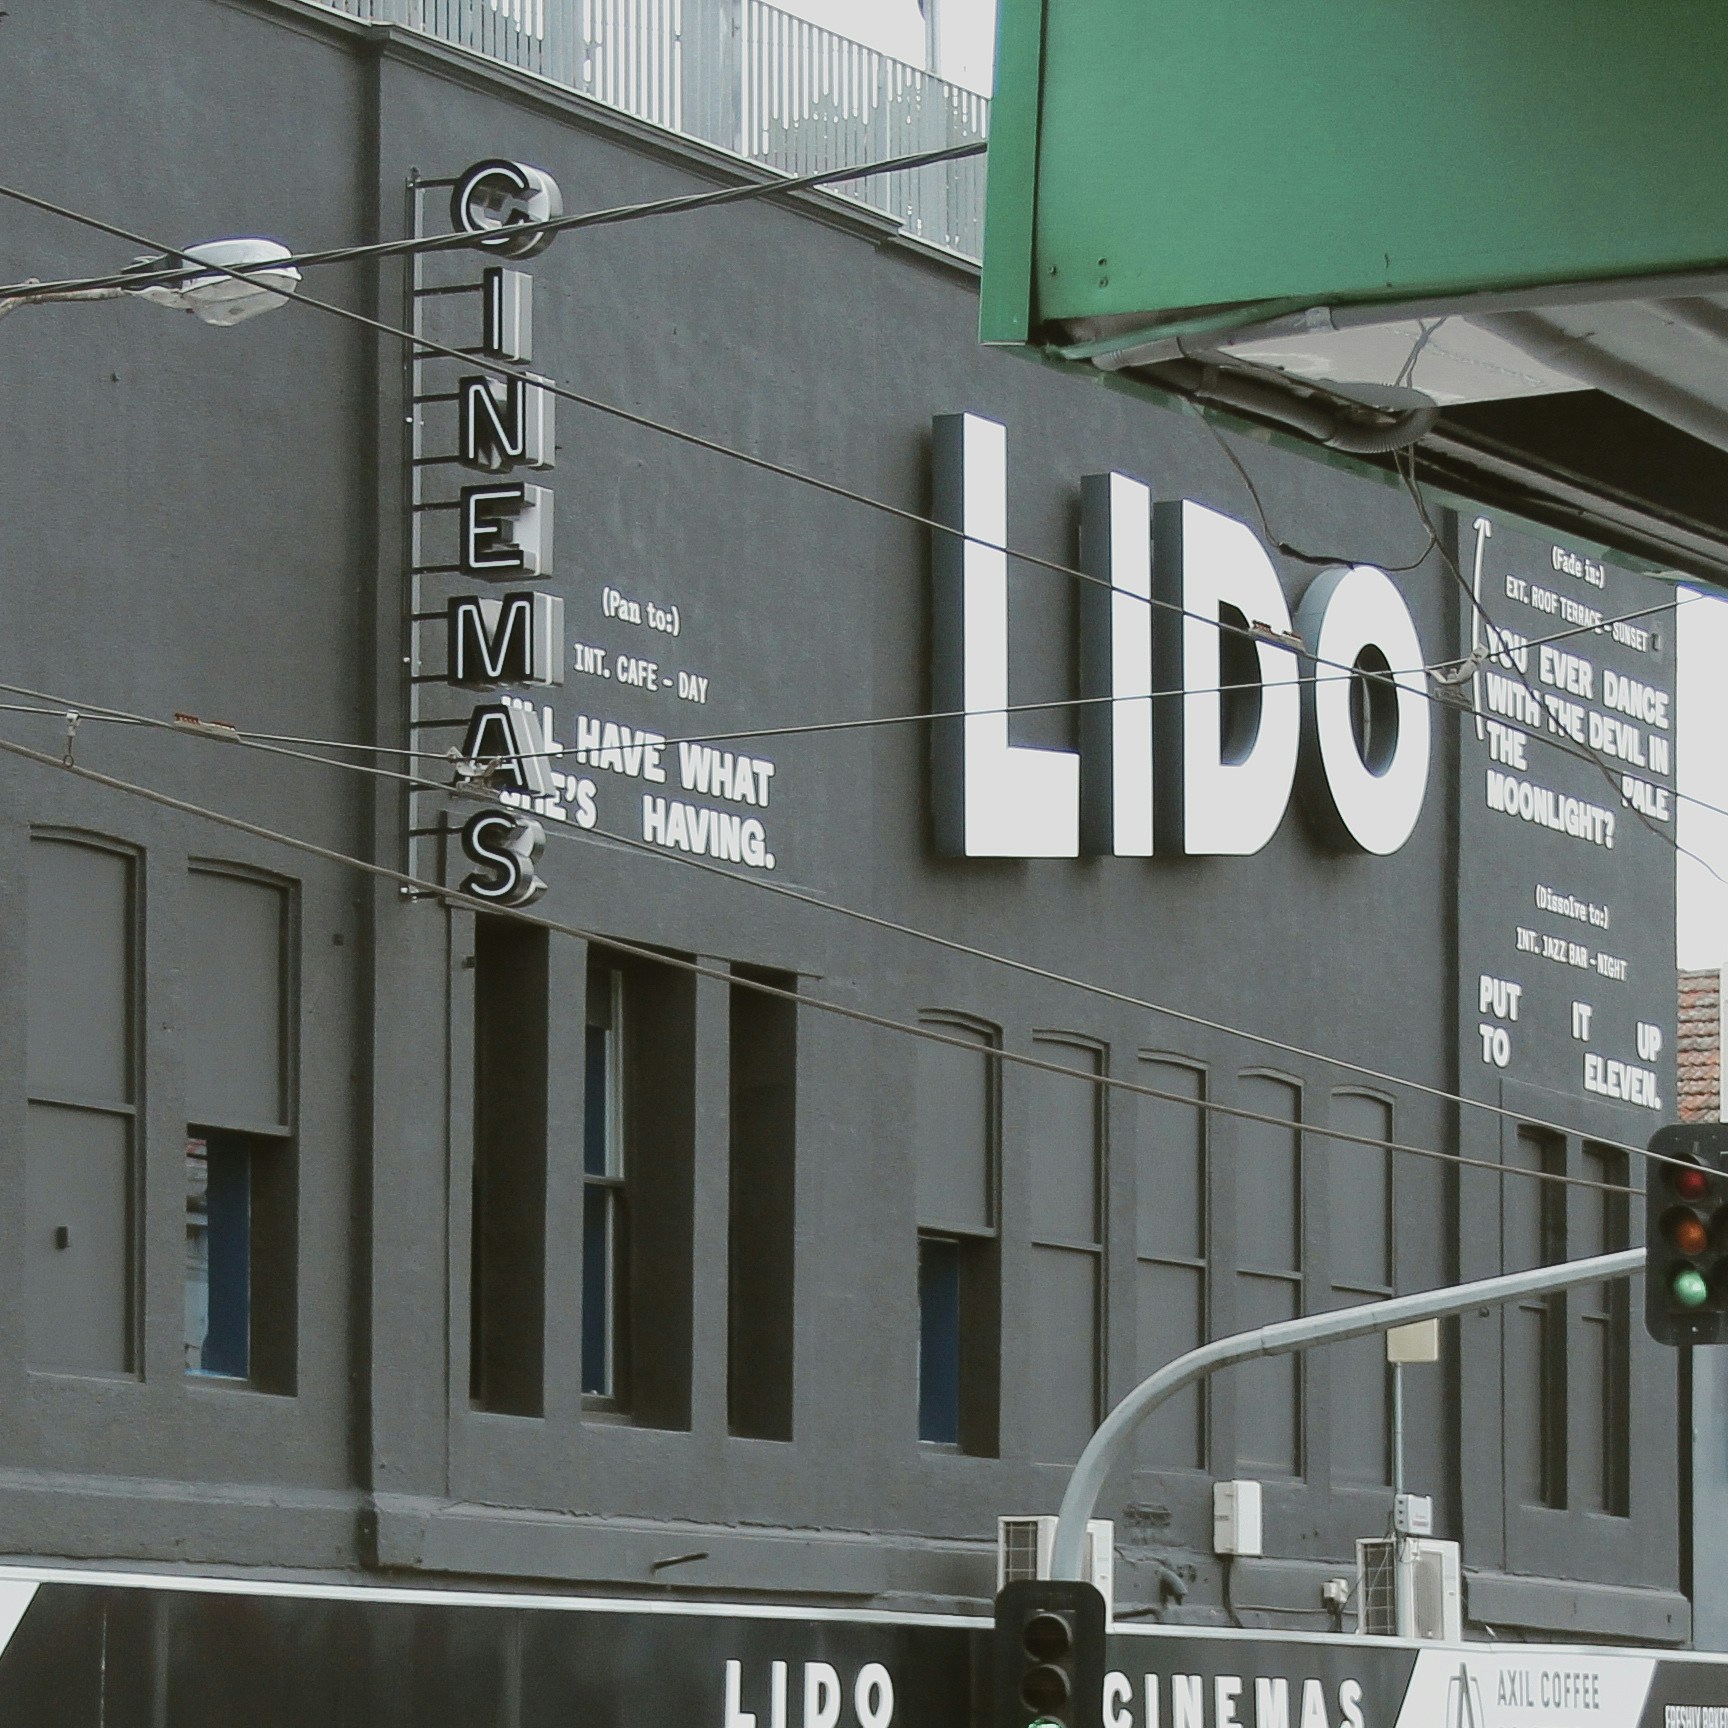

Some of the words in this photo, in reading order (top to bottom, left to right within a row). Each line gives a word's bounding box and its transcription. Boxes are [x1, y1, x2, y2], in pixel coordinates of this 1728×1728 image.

[451, 158, 564, 906] CINEMAS
[1551, 545, 1582, 579] (Fade
[602, 586, 642, 625] (Pan
[646, 601, 681, 636] to:)
[934, 412, 1430, 858] LIDO
[1505, 574, 1529, 605] EXT.
[1530, 585, 1559, 616] ROOF
[1560, 595, 1602, 634] TERRACE
[1611, 621, 1648, 653] SUNSET
[574, 642, 611, 679] INT.
[616, 654, 658, 691] CAFE
[678, 671, 708, 704] DAY
[1485, 623, 1529, 676] YOU
[1539, 644, 1593, 700] EVER
[1603, 669, 1669, 729] DANCE
[576, 714, 667, 783] HAVE
[679, 741, 775, 807] WHAT
[1485, 671, 1541, 728] WITH
[1544, 693, 1584, 745] THE
[1588, 710, 1646, 768] DEVIL
[1648, 733, 1670, 776] IN
[1485, 768, 1616, 851] MOONLIGHT?
[1486, 720, 1528, 771] THE
[1621, 773, 1670, 822] PALE
[642, 794, 776, 869] HAVING.
[1535, 883, 1587, 923] (Dissolve
[1588, 902, 1610, 930] to:)
[1516, 926, 1539, 954] INT.
[1542, 935, 1568, 963] JAZZ
[1569, 941, 1588, 969] BAR
[1597, 951, 1628, 981] NIGHT
[1479, 975, 1522, 1021] PUT
[1571, 1000, 1593, 1042] IT
[1636, 1021, 1663, 1062] UP
[1478, 1023, 1511, 1068] TO
[1583, 1052, 1662, 1110] ELEVEN.
[1496, 1669, 1534, 1708] AXIL
[1540, 1671, 1601, 1711] COFFEE
